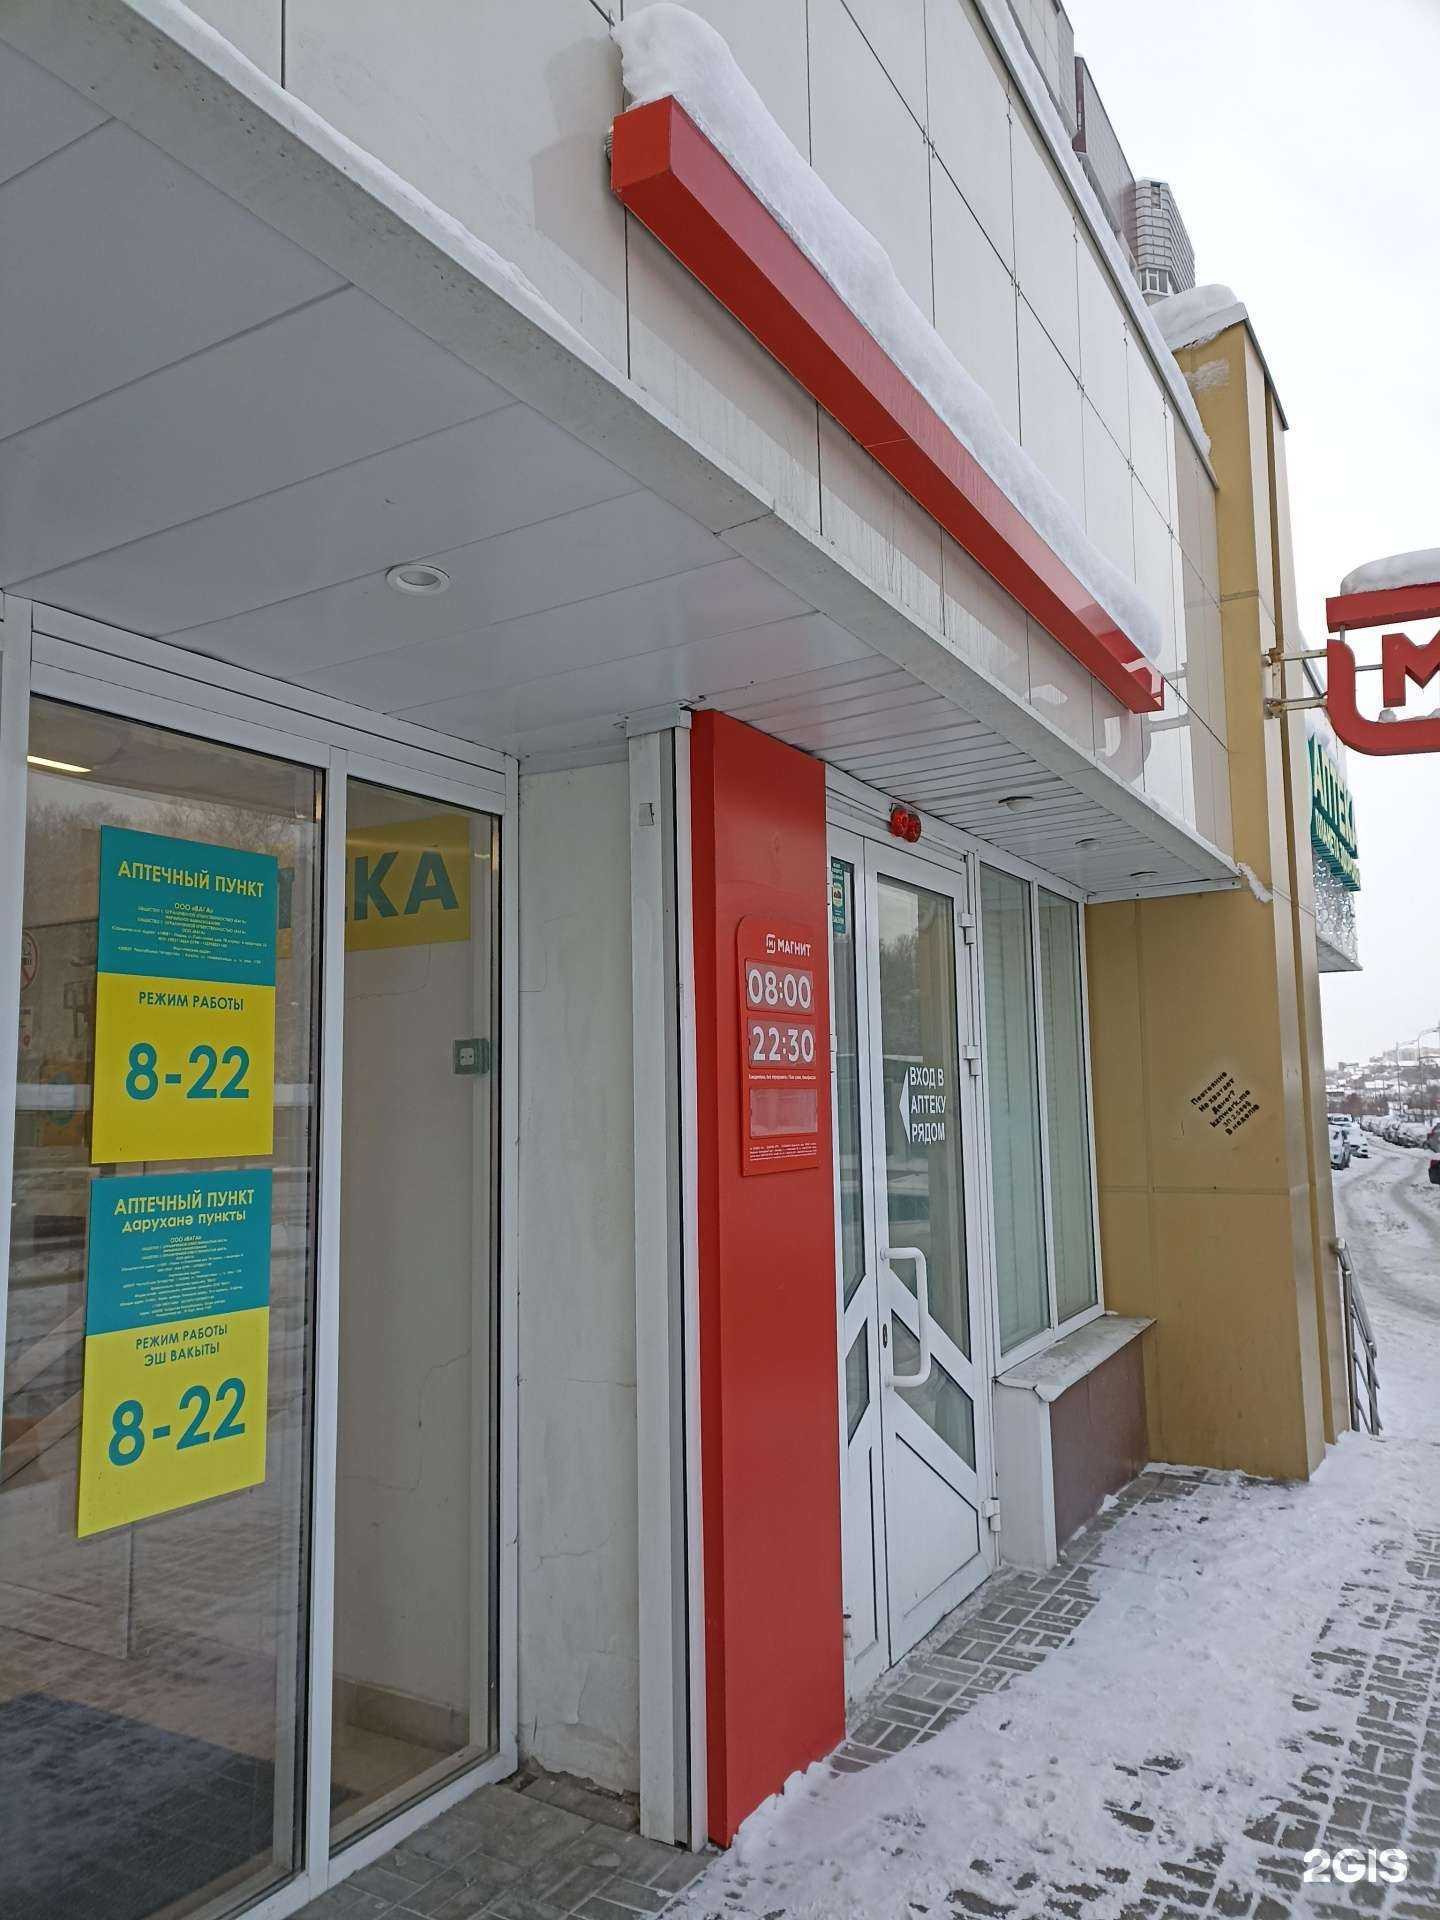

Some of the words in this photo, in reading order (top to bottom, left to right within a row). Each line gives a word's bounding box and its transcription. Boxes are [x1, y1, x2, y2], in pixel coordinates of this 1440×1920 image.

[118, 860, 210, 890] АПТЕЧНЫЙ
[215, 875, 264, 898] ПУНКТ
[778, 939, 811, 957] МАГНИТ
[748, 969, 811, 1008] 08:00
[139, 992, 189, 1008] РЕЖИМ
[192, 995, 244, 1011] РАБОТЫ
[752, 1026, 814, 1062] 22:30
[125, 1042, 250, 1100] 8-22
[910, 1067, 936, 1089] ВХОД
[938, 1068, 944, 1086] В
[911, 1095, 946, 1114] АПТЕКУ
[912, 1123, 945, 1144] РЯДОМ
[113, 1189, 202, 1215] АПТЕЧНЫЙ
[207, 1189, 255, 1208] ПУНКТ
[198, 1210, 246, 1226] пункты
[136, 1332, 179, 1350] РЕЖИМ
[183, 1324, 228, 1341] РАБОТЫ
[144, 1353, 166, 1367] ЭШ
[171, 1342, 220, 1362] ВАКЫТЫ
[108, 1378, 246, 1466] 8-22
